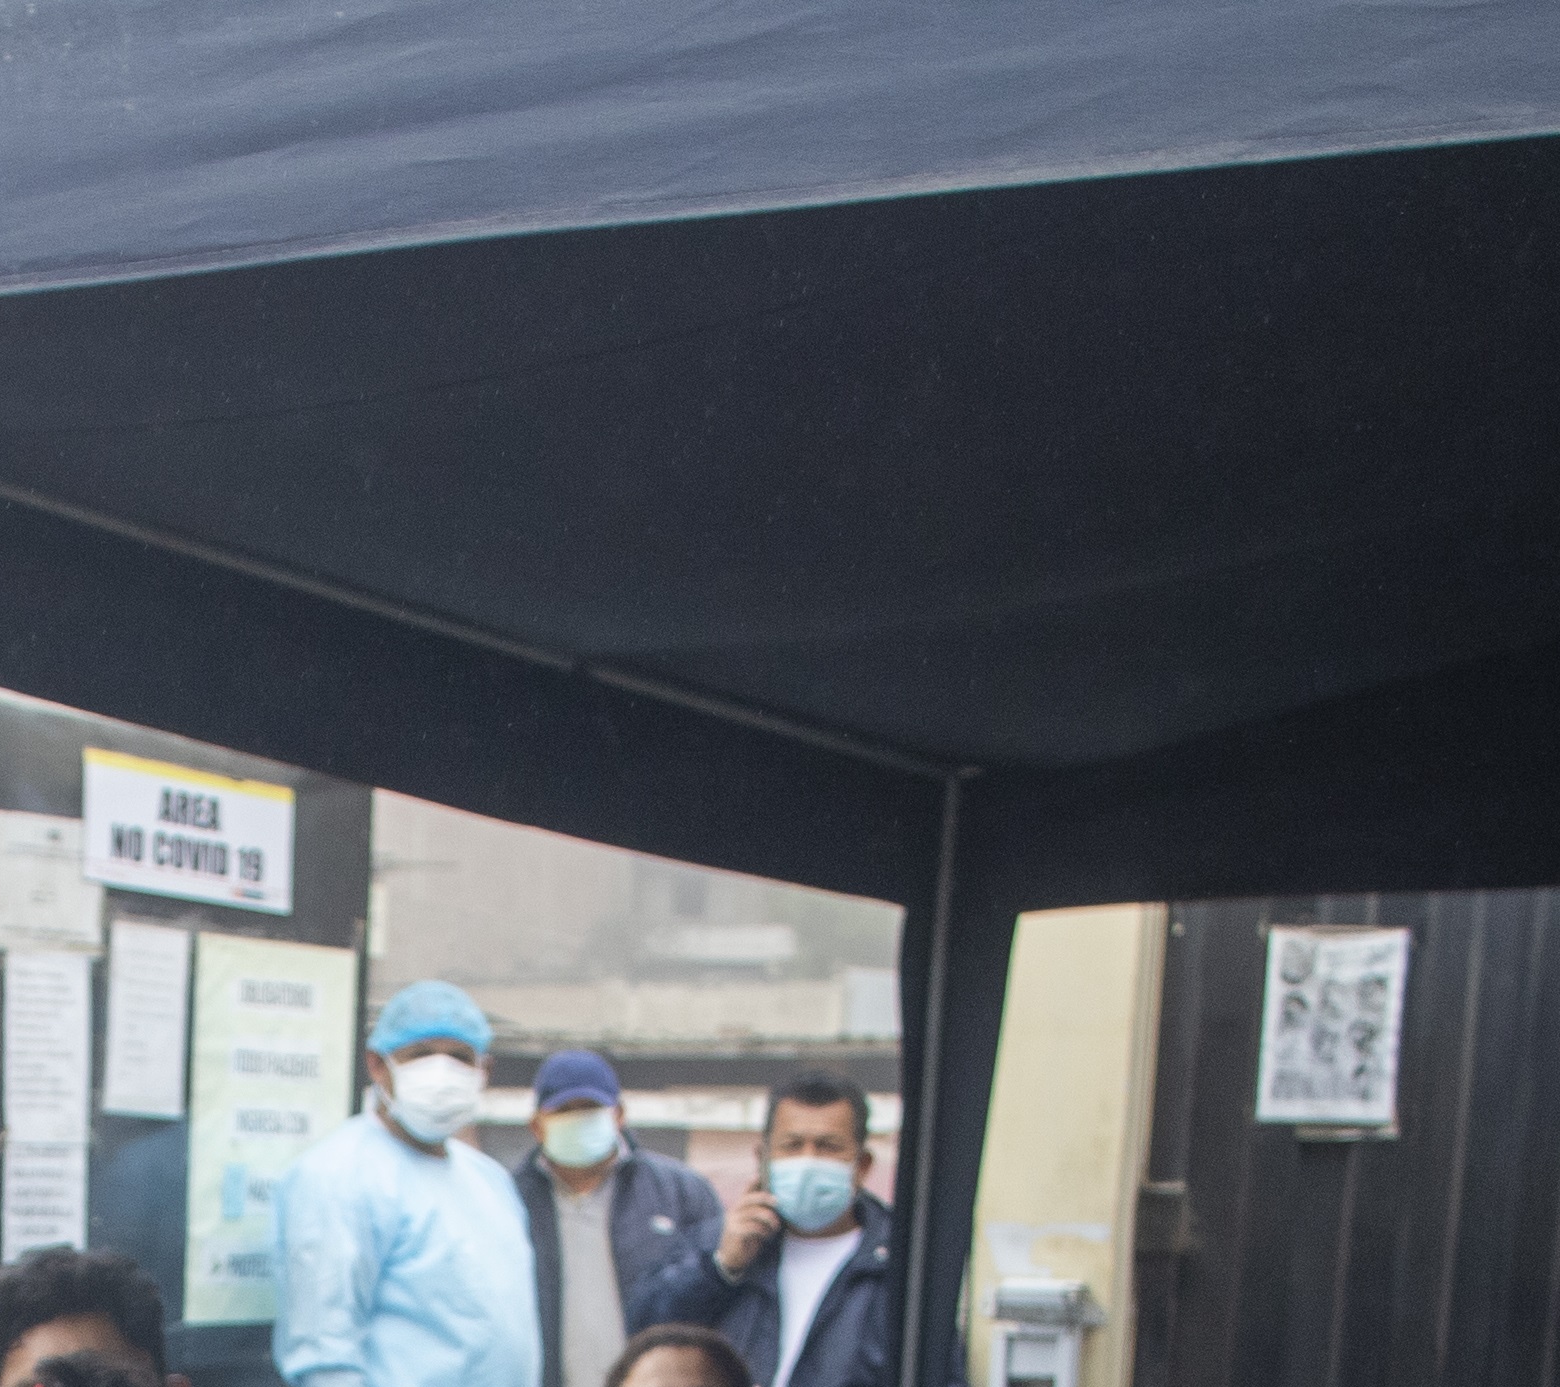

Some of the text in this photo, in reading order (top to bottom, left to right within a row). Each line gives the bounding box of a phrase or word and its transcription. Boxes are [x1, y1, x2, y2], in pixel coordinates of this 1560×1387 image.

[159, 786, 220, 831] AREA
[111, 822, 263, 881] NO COVID 19
